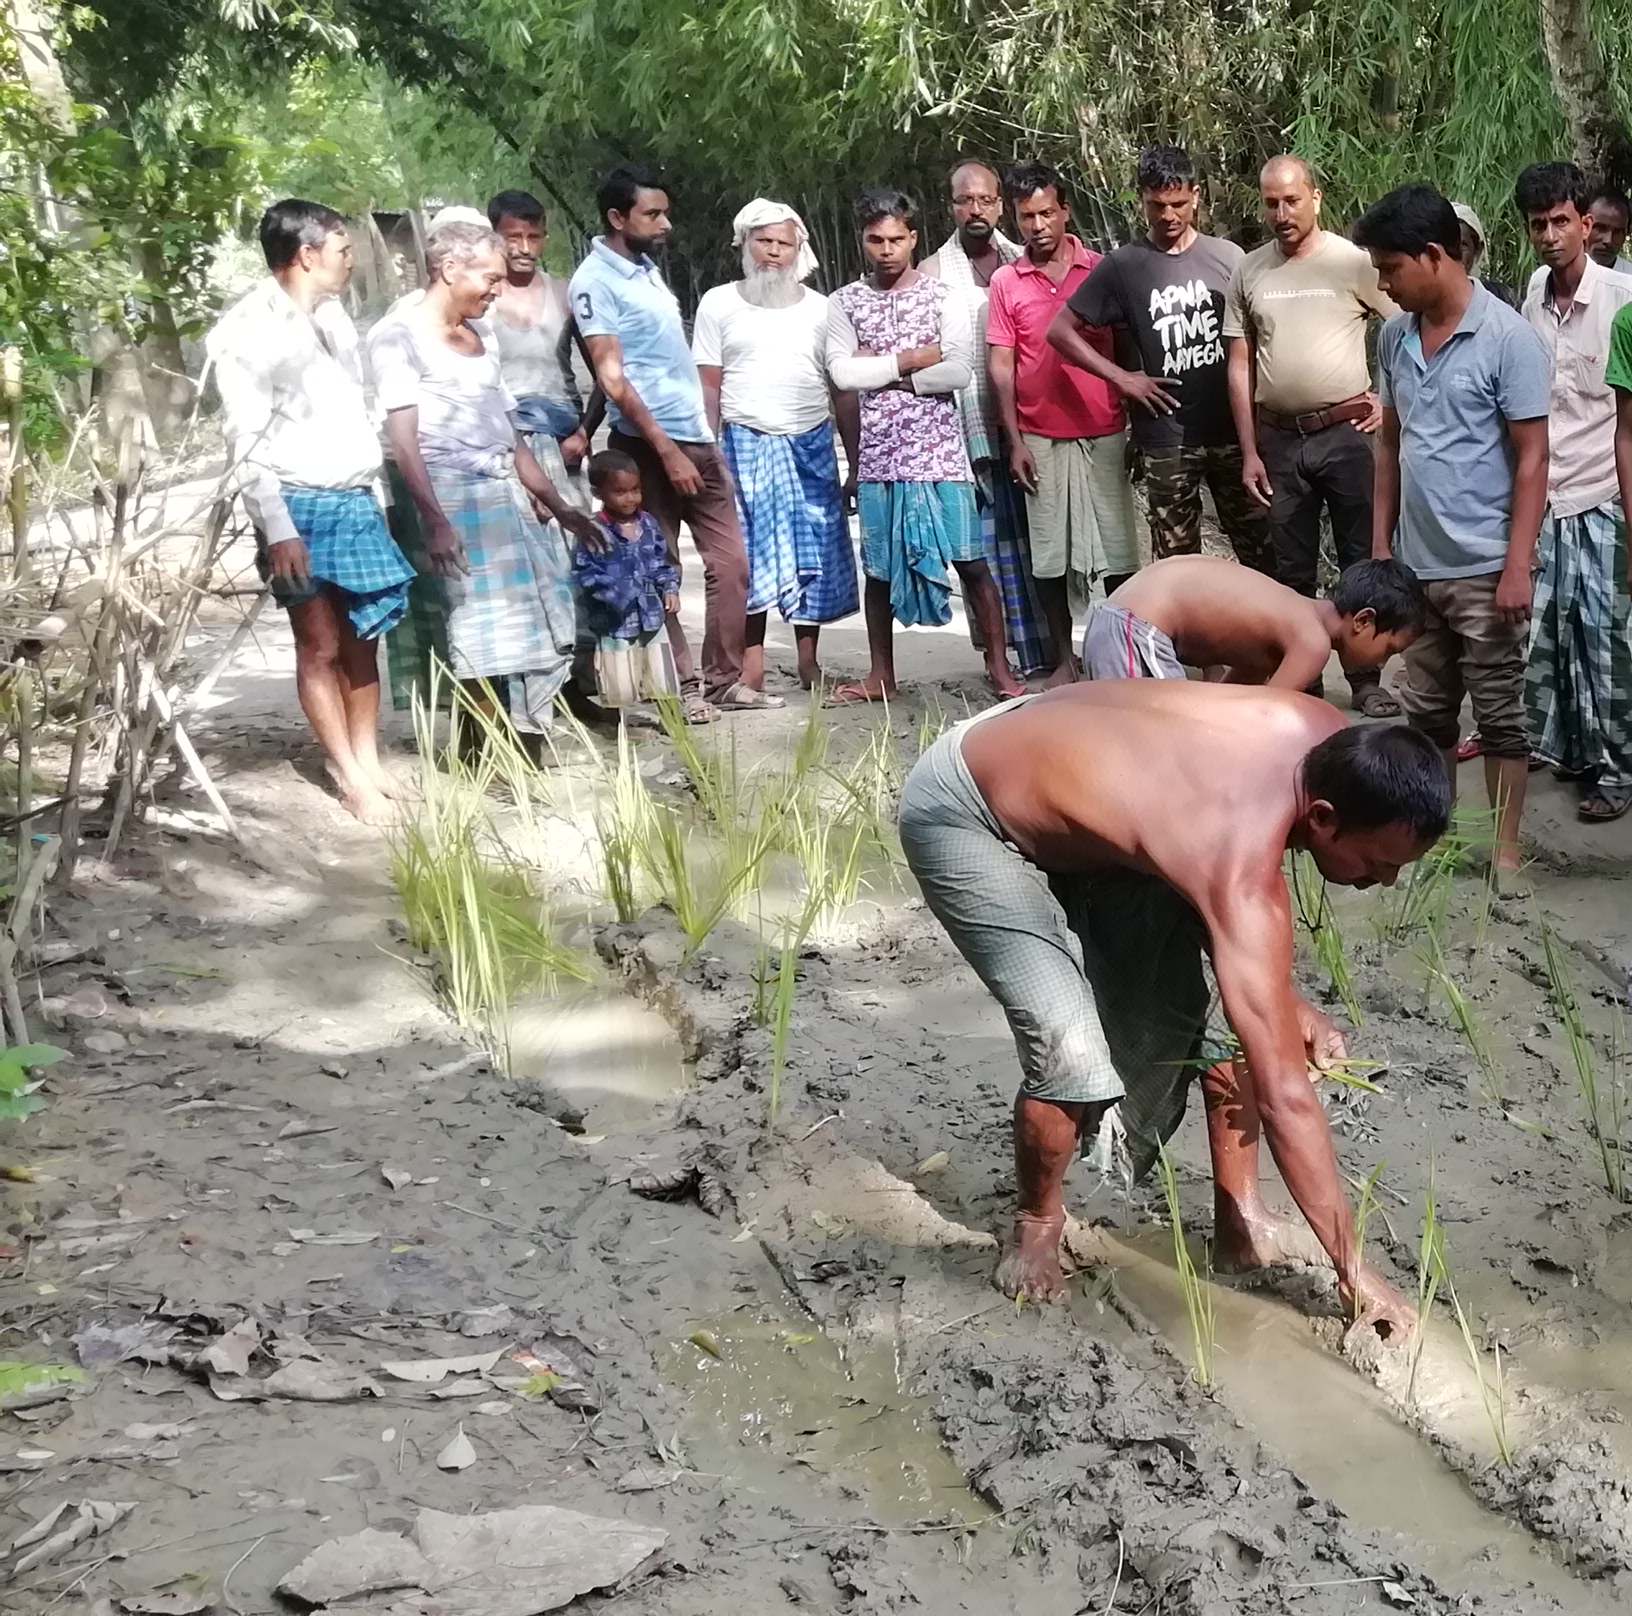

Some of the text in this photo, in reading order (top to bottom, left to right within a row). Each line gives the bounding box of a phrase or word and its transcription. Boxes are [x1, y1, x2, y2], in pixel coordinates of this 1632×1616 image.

[578, 292, 594, 320] 3
[1148, 279, 1213, 320] APNA
[1162, 338, 1225, 377] AAYEGA
